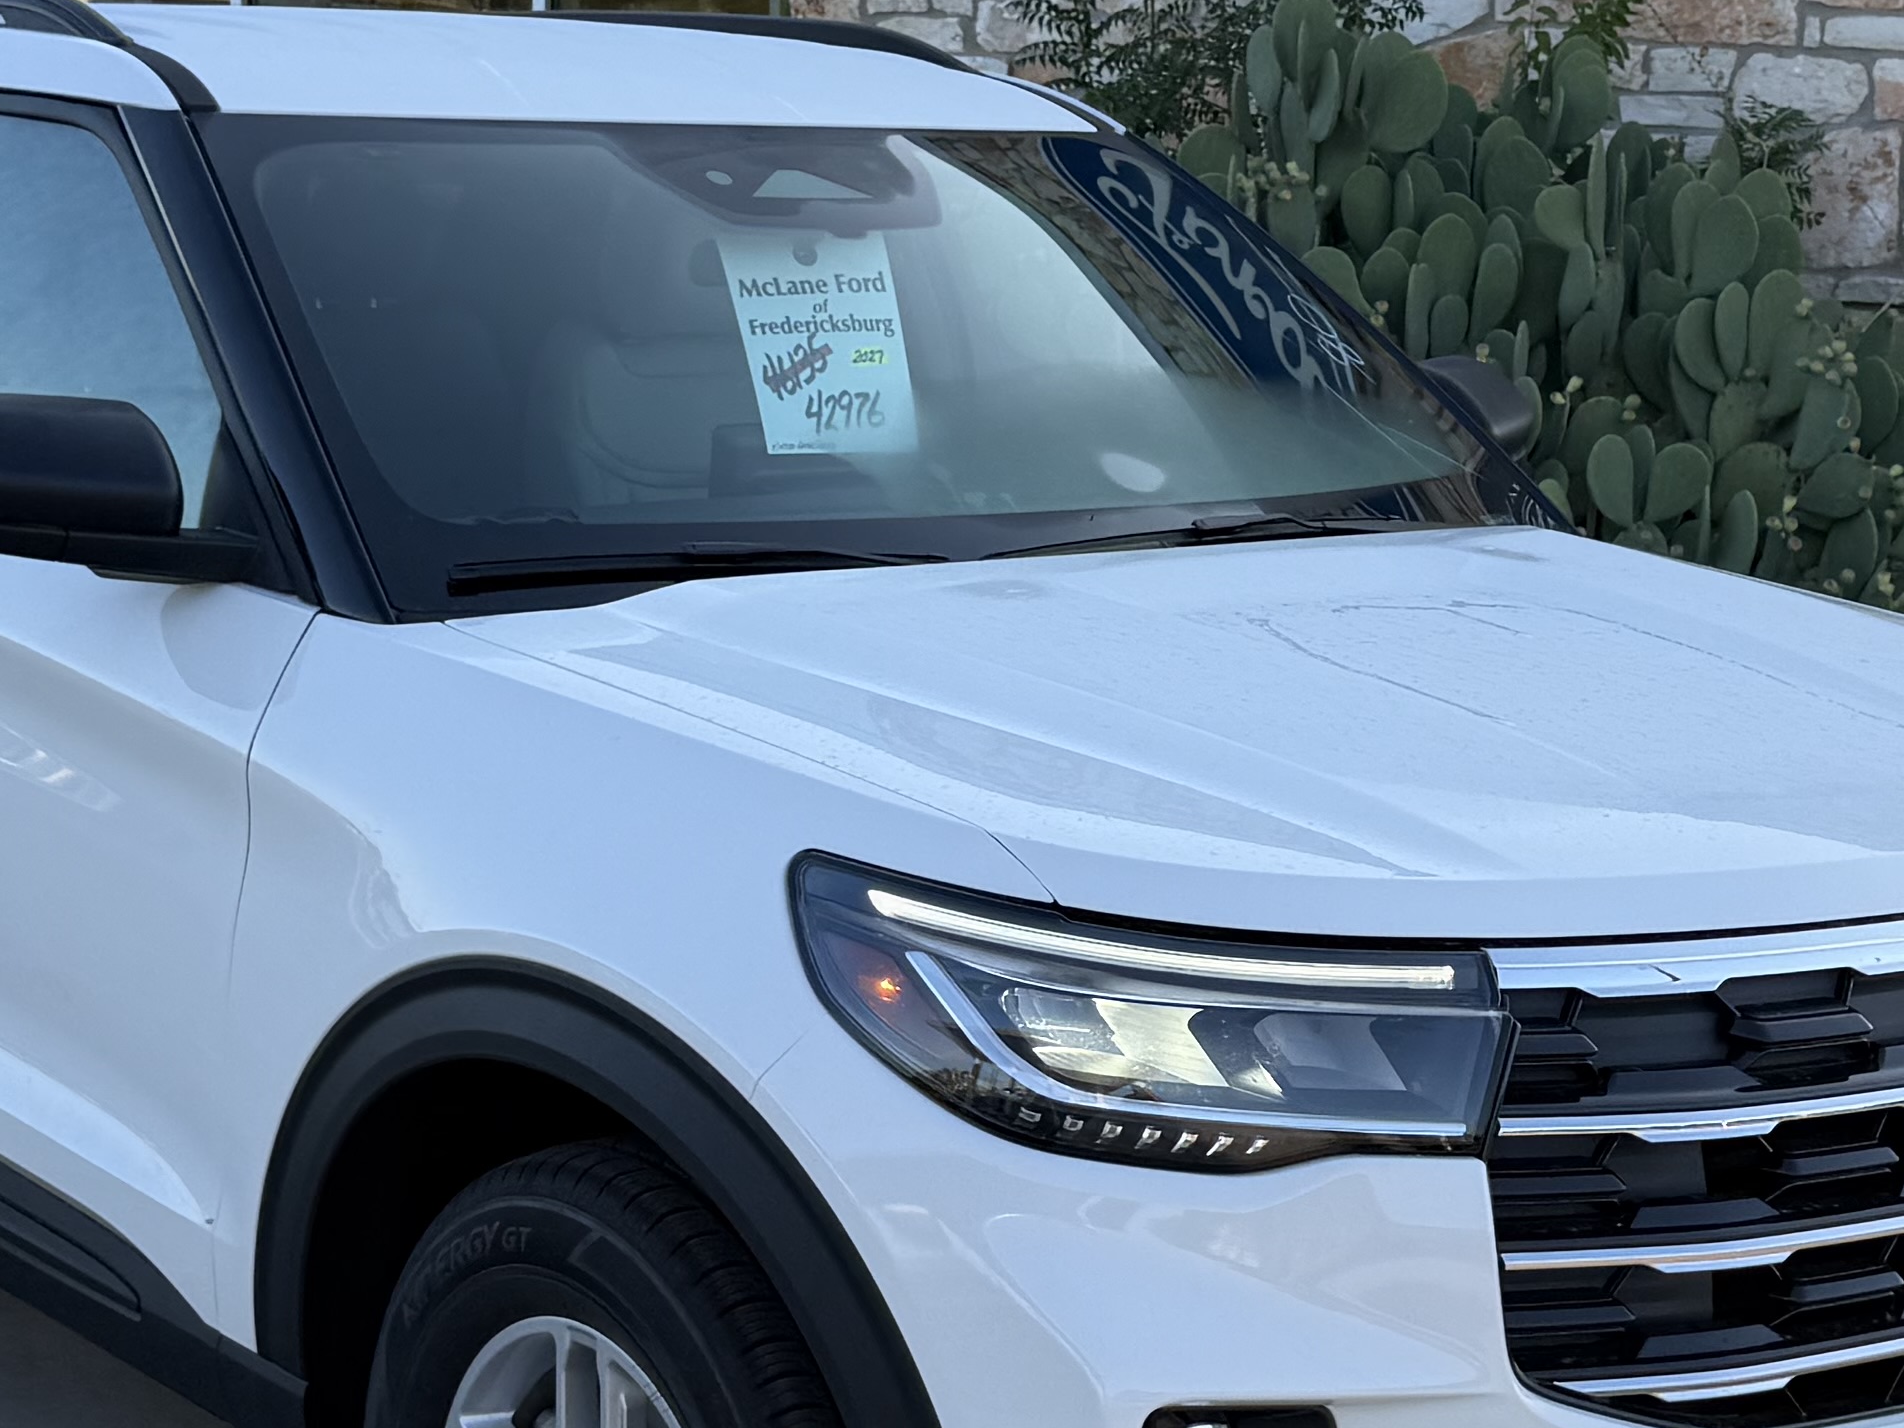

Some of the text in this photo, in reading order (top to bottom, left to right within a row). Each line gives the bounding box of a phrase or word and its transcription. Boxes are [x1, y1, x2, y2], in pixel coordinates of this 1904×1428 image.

[738, 271, 887, 299] McLane Ford
[812, 299, 829, 314] of
[748, 314, 896, 338] Fredericksburg
[805, 389, 886, 435] 42976
